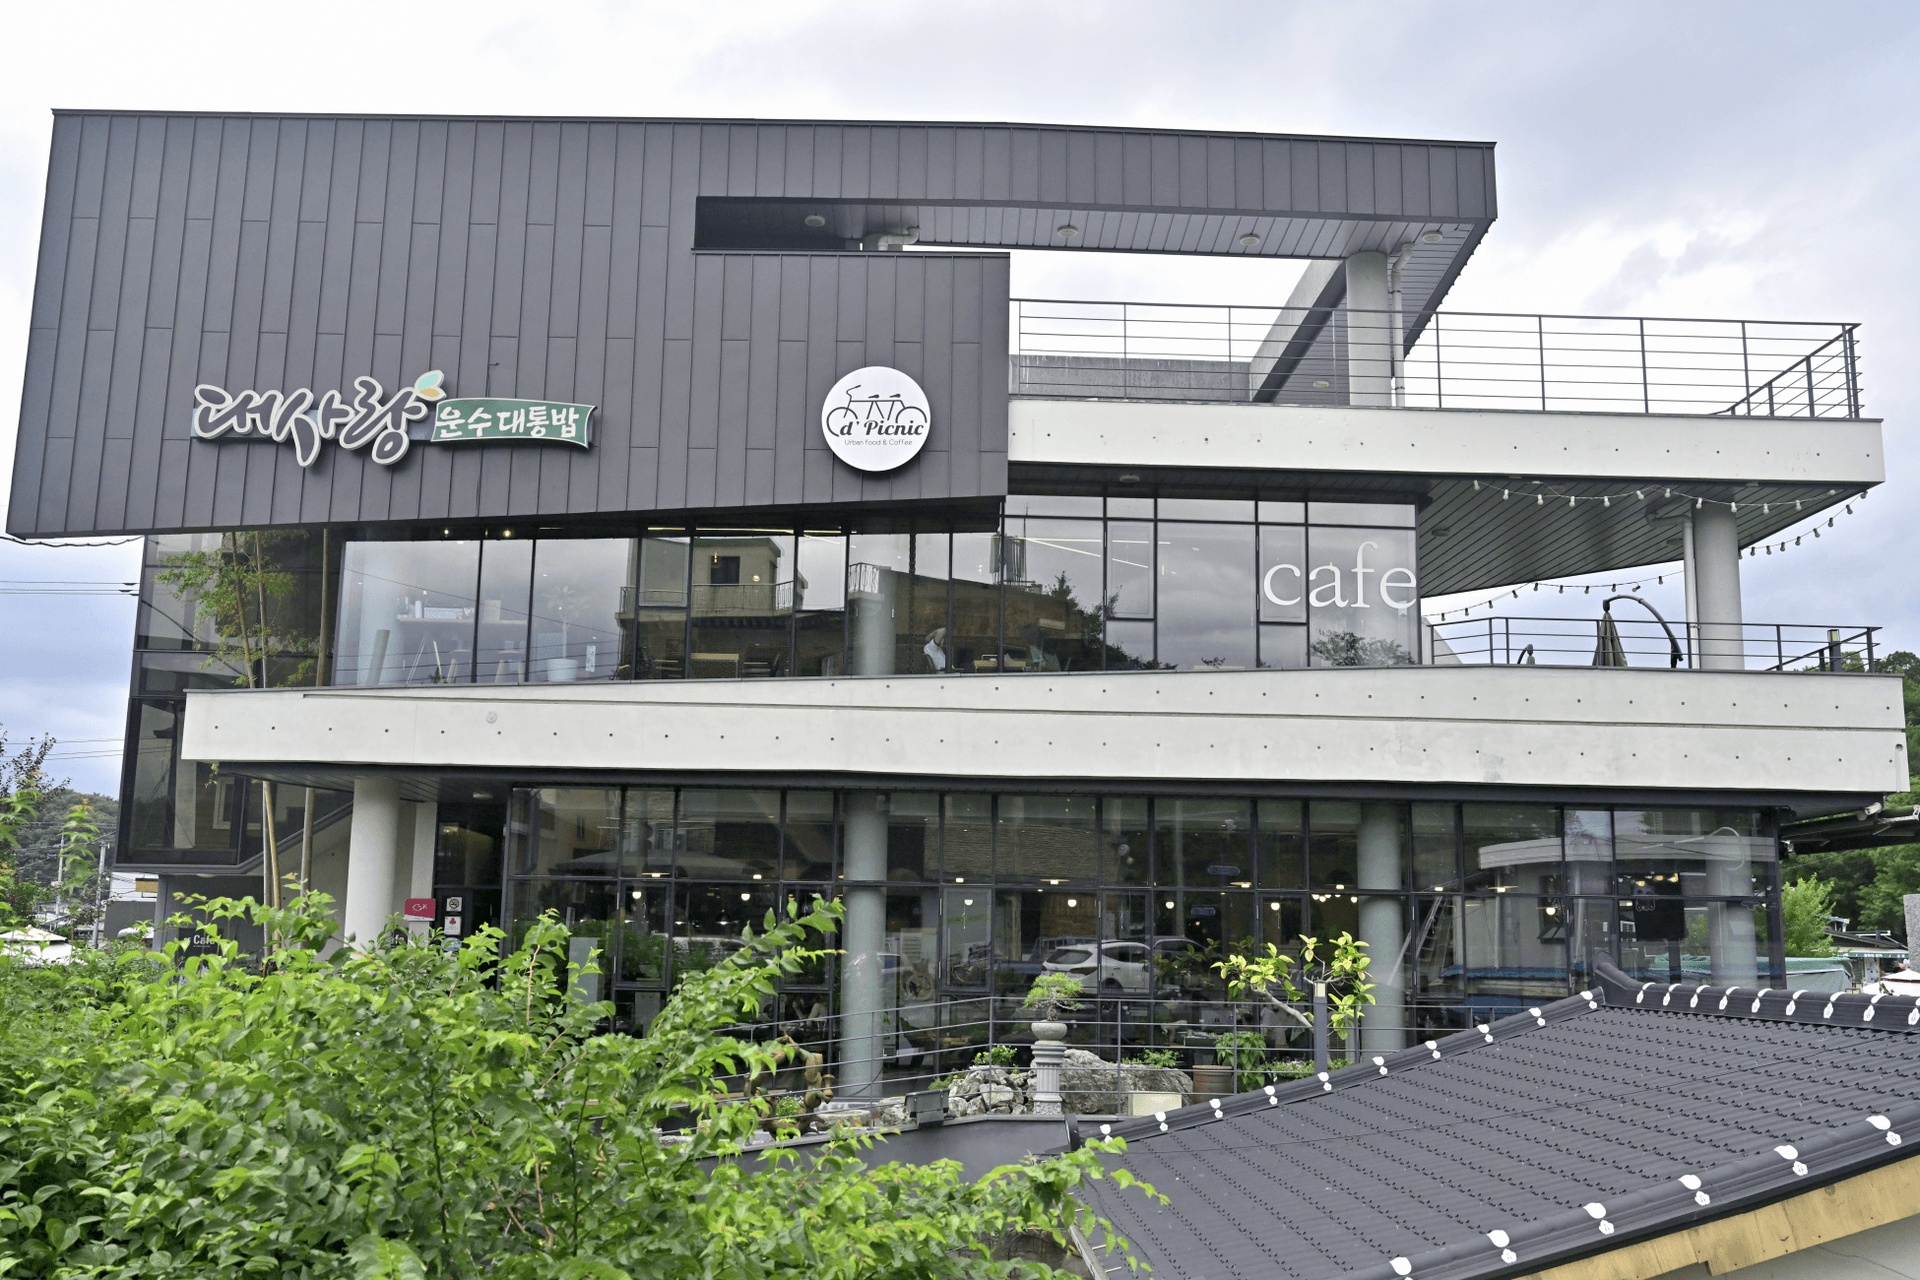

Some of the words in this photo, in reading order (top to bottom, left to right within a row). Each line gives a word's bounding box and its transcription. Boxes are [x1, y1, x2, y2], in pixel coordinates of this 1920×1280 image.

[436, 405, 580, 438] 운수대통밥
[863, 419, 925, 436] Picnic
[1263, 541, 1417, 609] cafe
